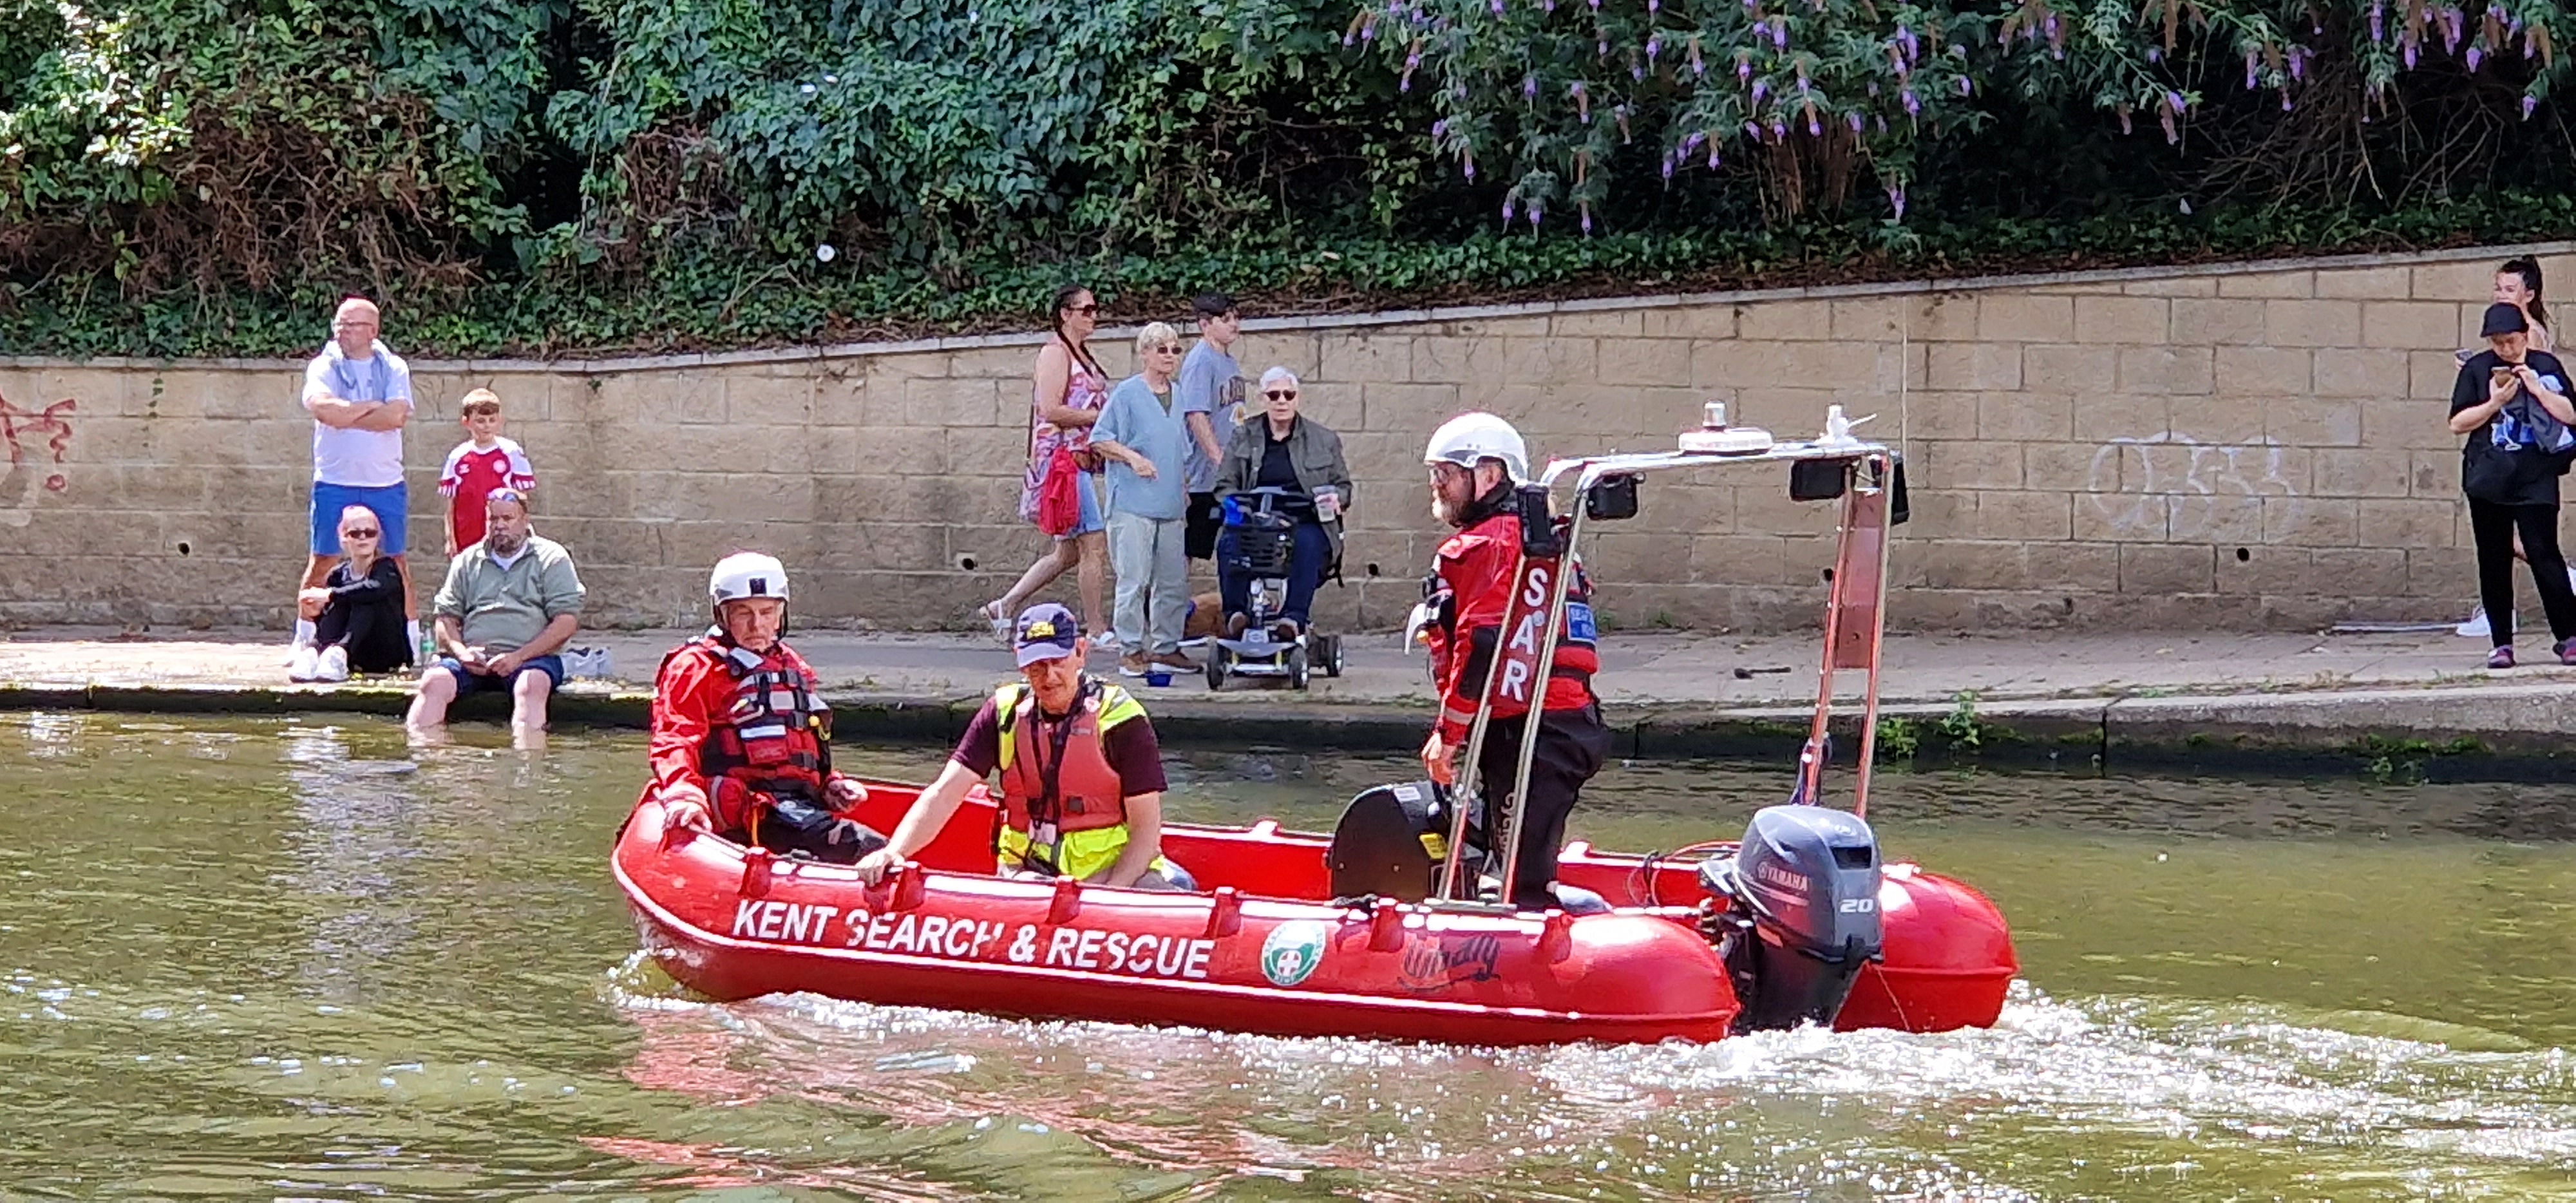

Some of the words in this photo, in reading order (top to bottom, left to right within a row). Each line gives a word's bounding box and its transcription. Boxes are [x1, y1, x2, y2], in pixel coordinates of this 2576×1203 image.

[1499, 567, 1548, 703] SAR
[1766, 867, 1808, 891] YAMAHA
[1840, 898, 1873, 913] 20
[732, 898, 838, 943] KENT
[844, 908, 1005, 958] SEARCH
[1008, 924, 1037, 963] &
[1045, 926, 1215, 979] RESCUE
